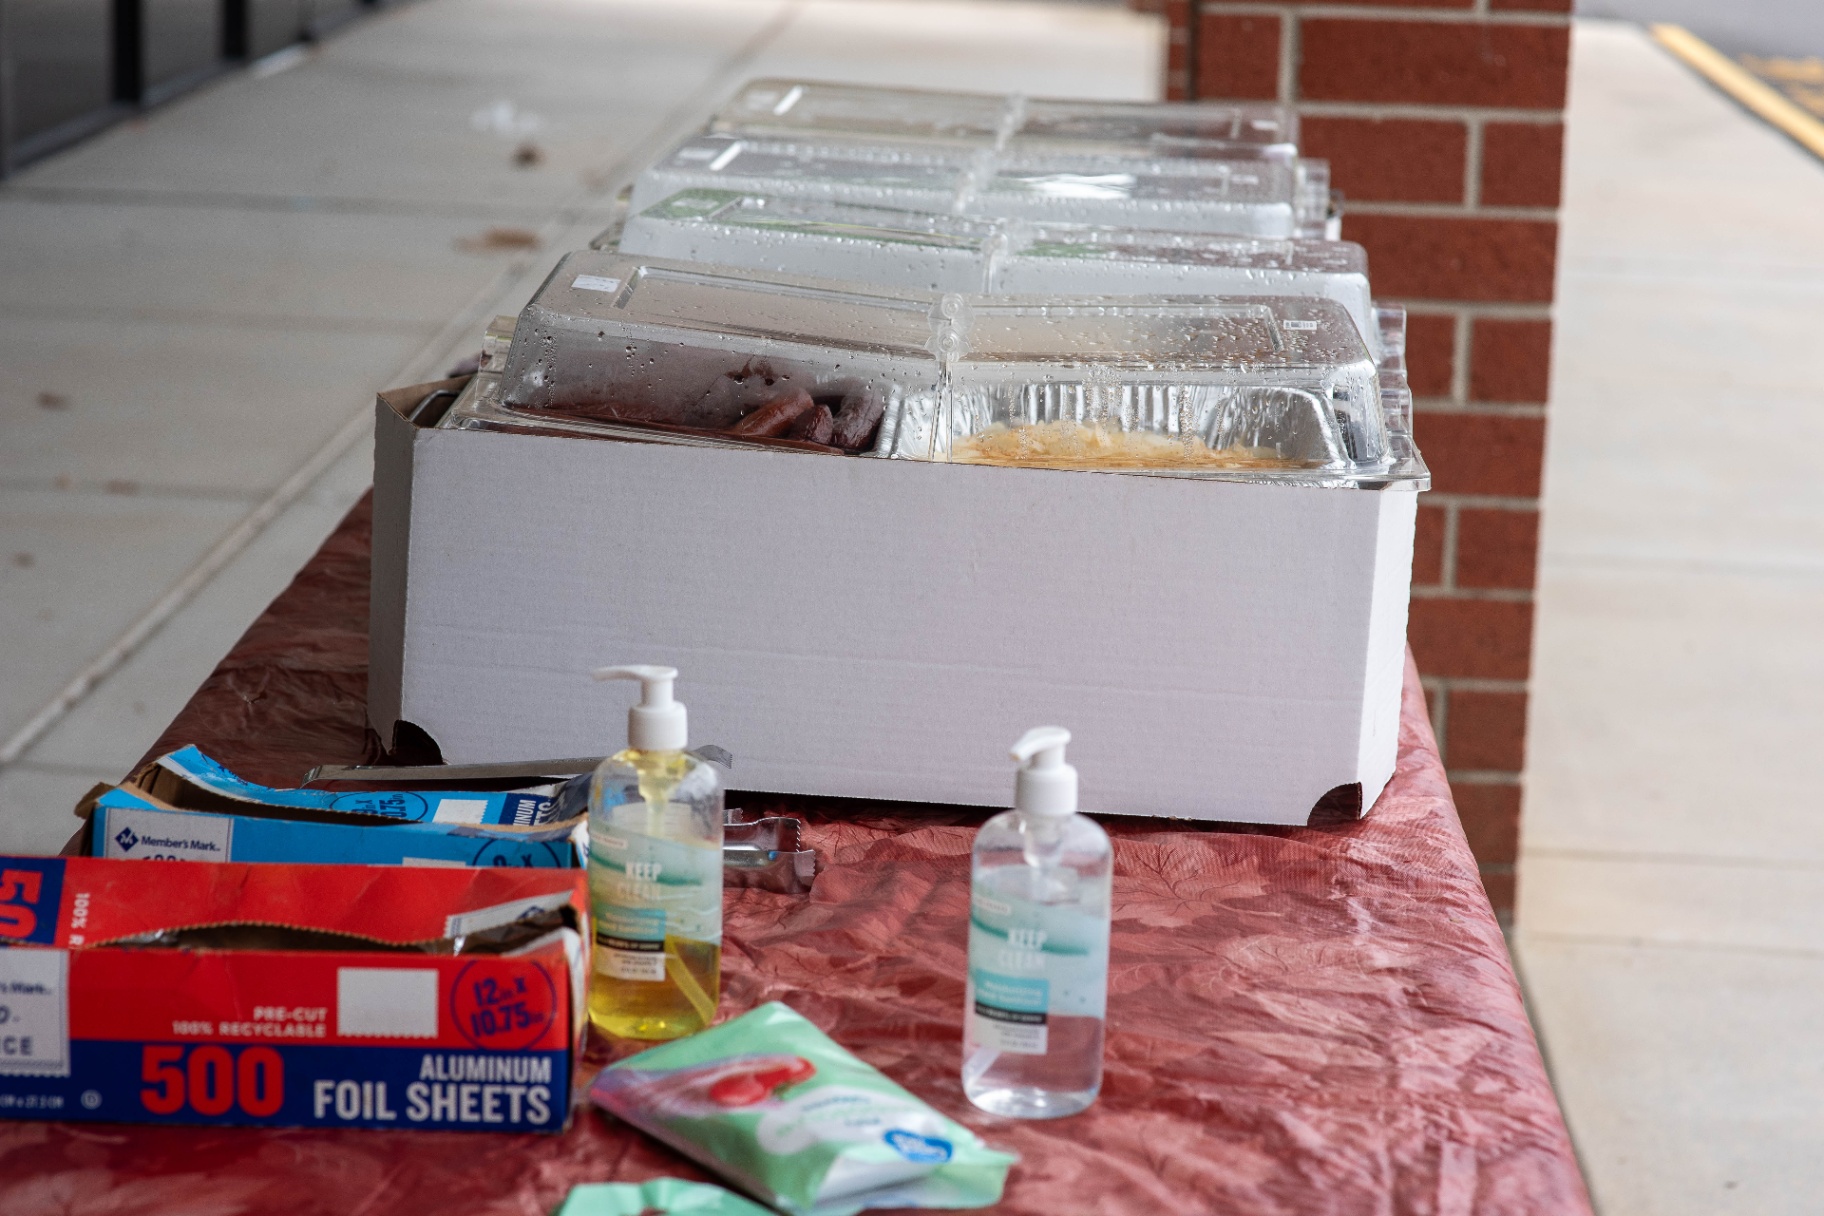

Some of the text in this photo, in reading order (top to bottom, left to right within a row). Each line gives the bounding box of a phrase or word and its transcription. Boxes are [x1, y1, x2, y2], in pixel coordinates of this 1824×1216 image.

[141, 835, 217, 852] Member's Mark
[625, 861, 663, 881] KEEP
[71, 893, 90, 930] 100%
[1007, 927, 1048, 949] KEEP
[998, 949, 1046, 970] CLEAN
[253, 1005, 328, 1022] PRE-CUT
[172, 1020, 327, 1039] 100% RECYCLABLE
[419, 1054, 552, 1084] ALUMINUM
[140, 1044, 284, 1118] 500
[313, 1079, 551, 1126] FOIL SHEETS
